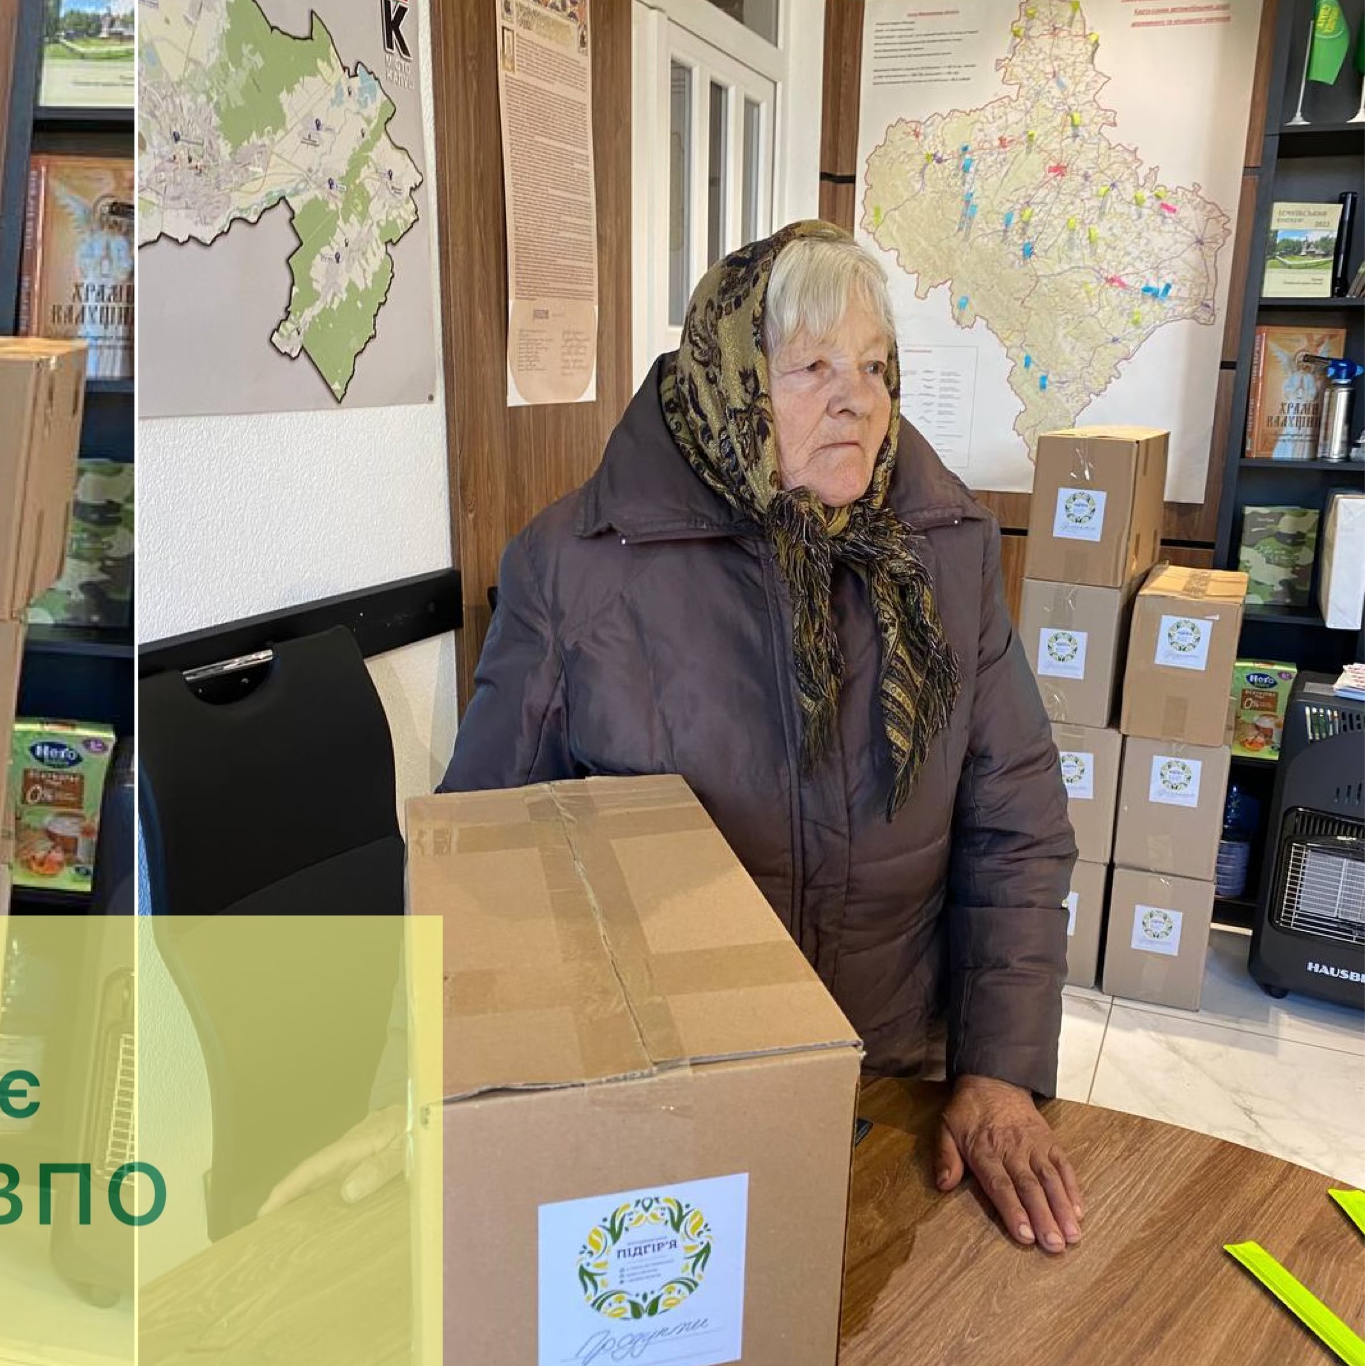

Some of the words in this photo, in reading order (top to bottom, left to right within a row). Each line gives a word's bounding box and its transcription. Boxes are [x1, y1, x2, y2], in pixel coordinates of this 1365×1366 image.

[1249, 673, 1274, 687] Hero
[33, 742, 76, 762] Hero
[616, 1237, 679, 1261] ПІДГІР'Я
